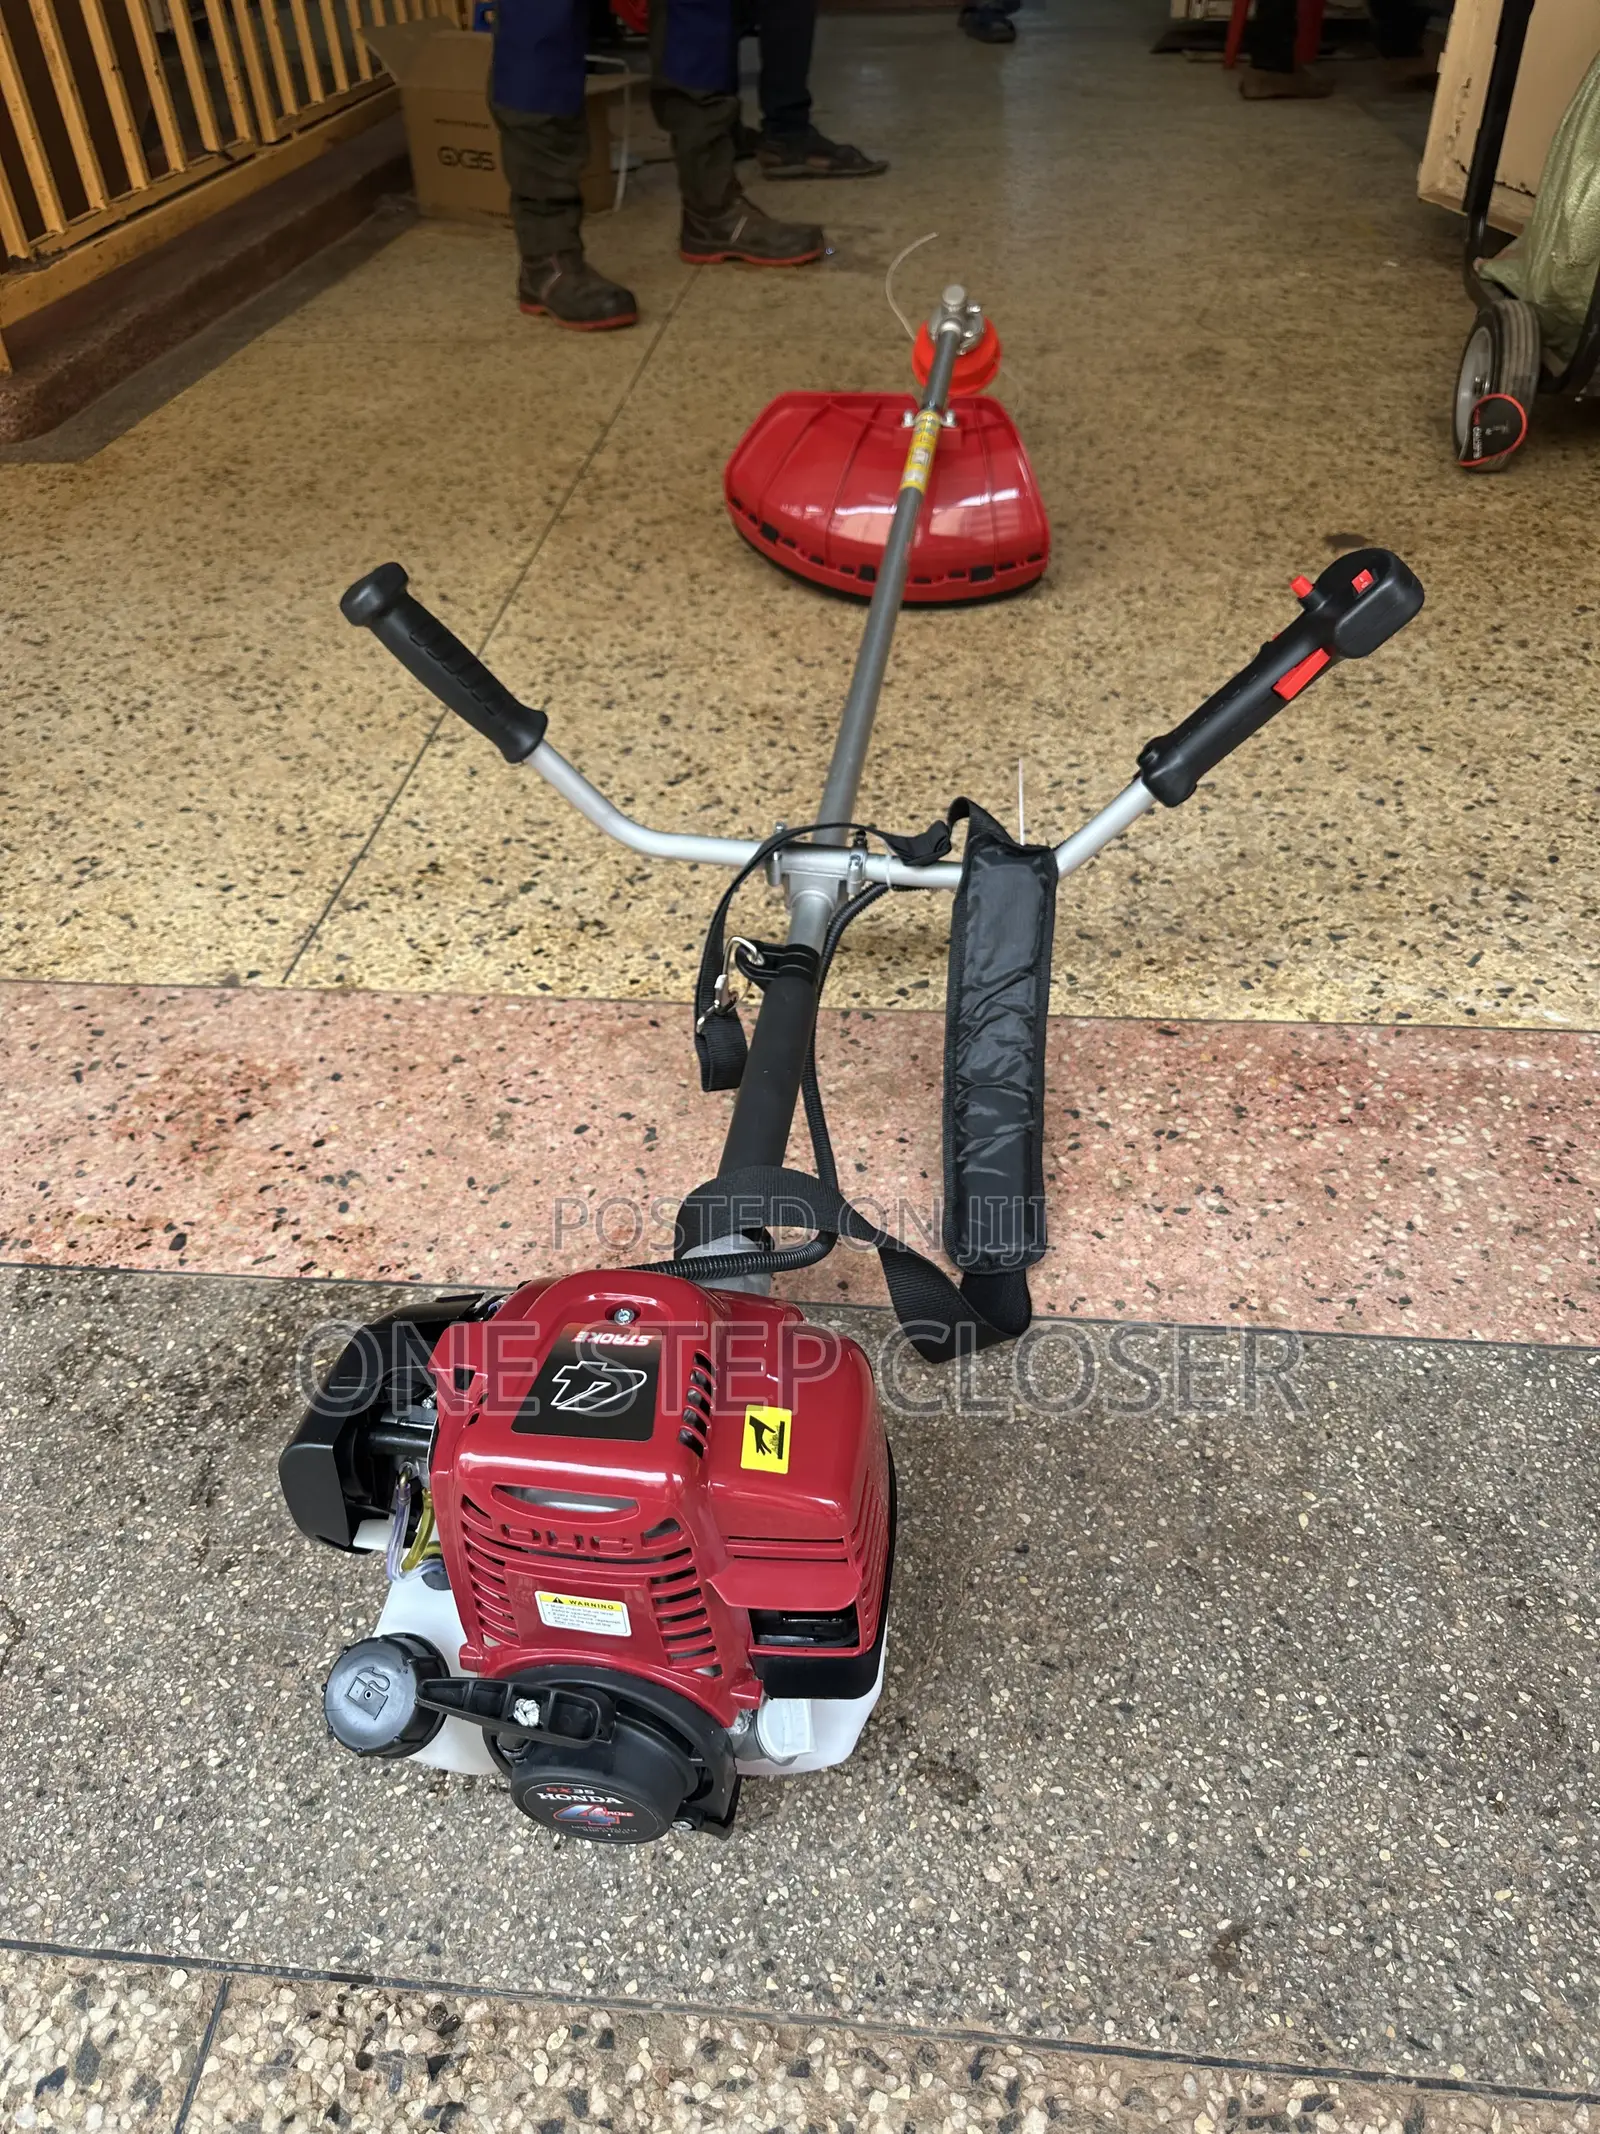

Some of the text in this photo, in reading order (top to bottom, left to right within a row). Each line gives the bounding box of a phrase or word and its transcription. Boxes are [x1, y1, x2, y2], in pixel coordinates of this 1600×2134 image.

[572, 1331, 655, 1347] STROKE
[568, 1599, 615, 1610] WARNING
[536, 1792, 625, 1805] HONDA
